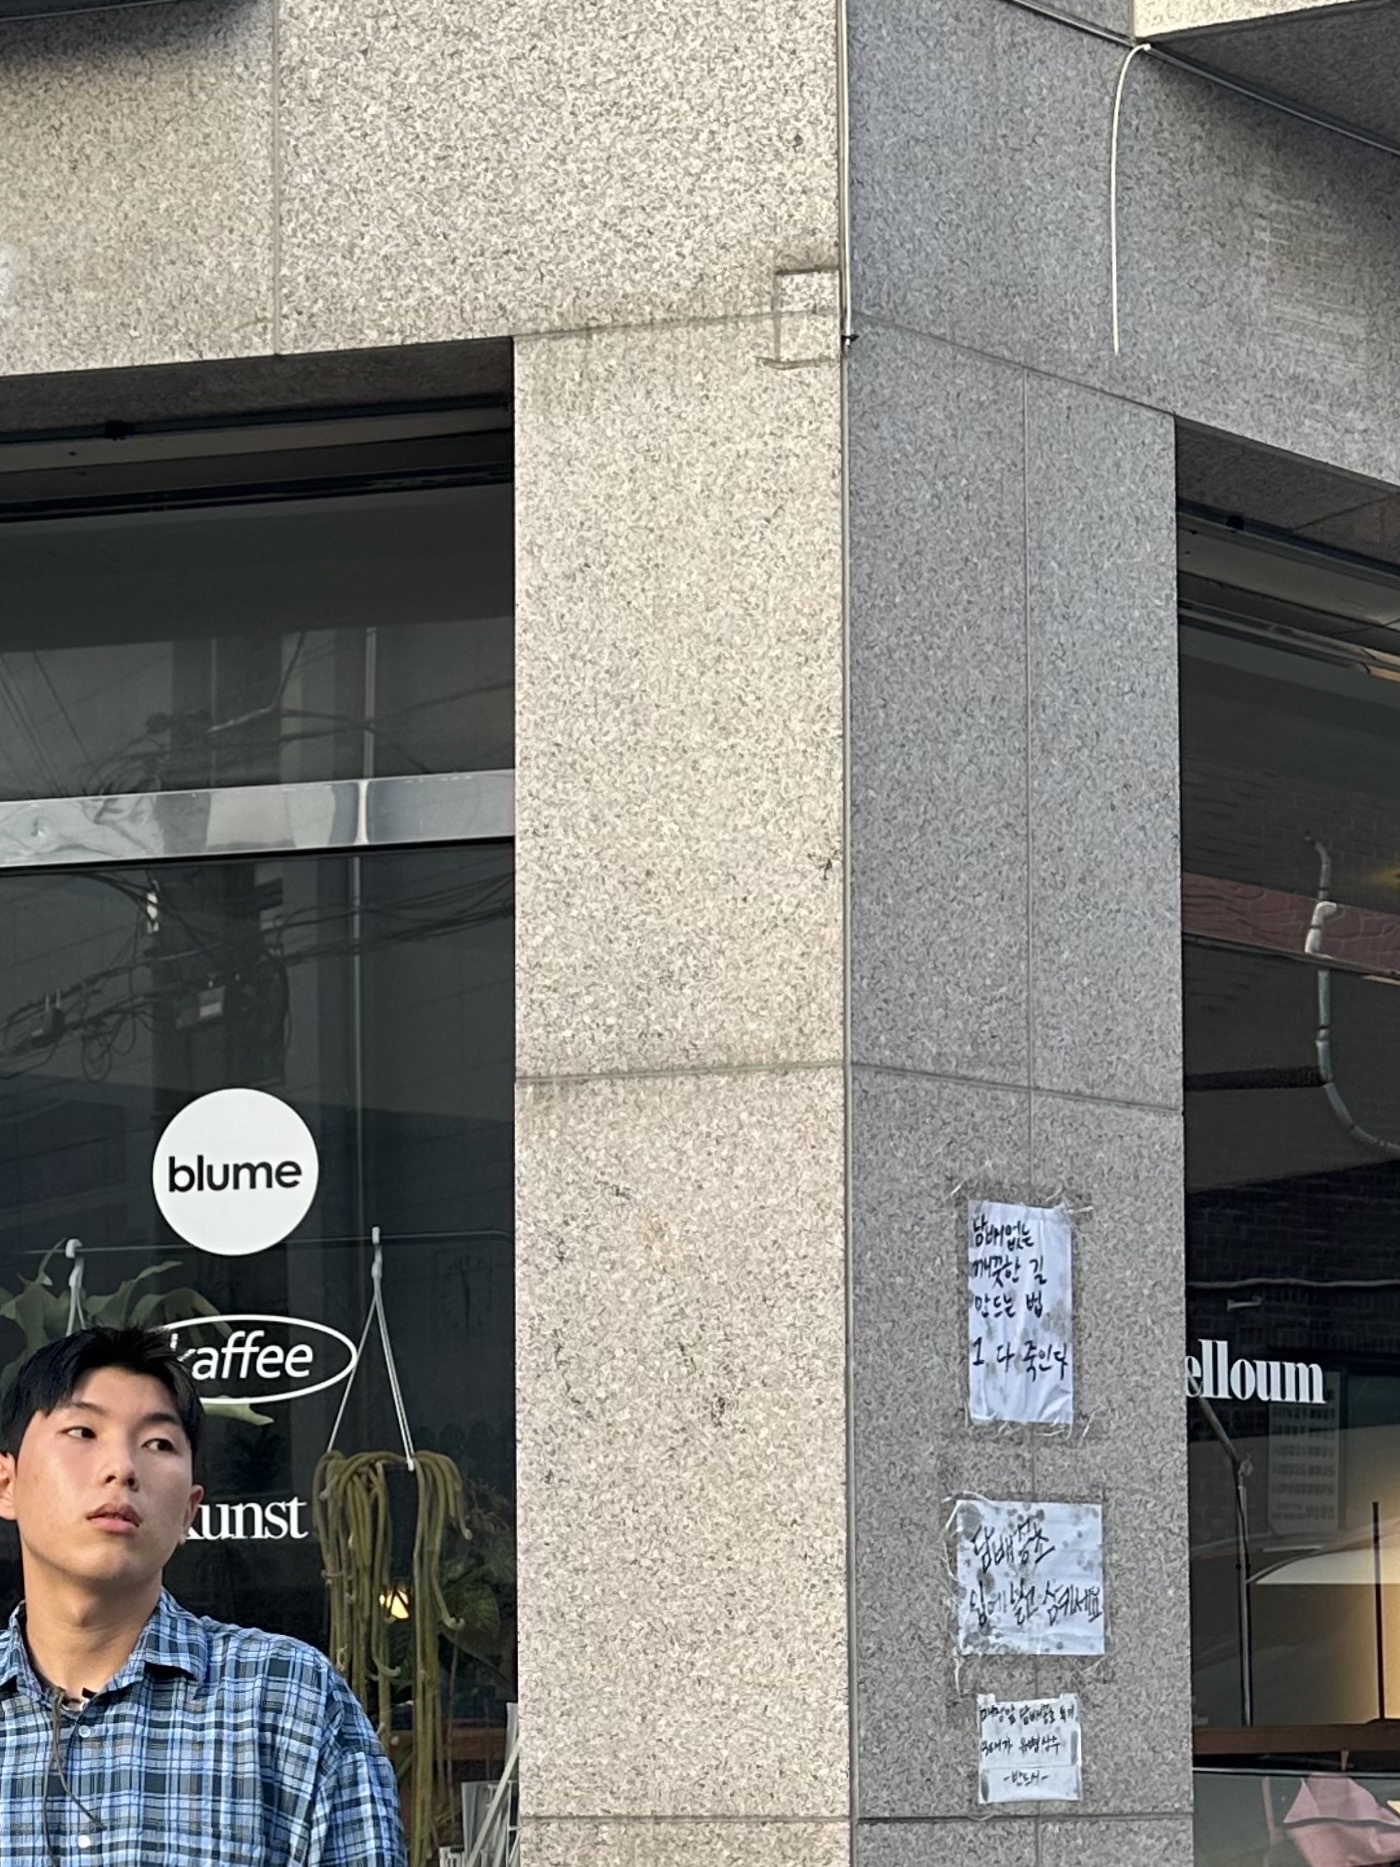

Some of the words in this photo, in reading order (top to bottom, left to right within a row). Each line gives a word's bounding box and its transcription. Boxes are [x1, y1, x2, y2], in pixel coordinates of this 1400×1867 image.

[168, 1155, 302, 1192] blume
[972, 1255, 1021, 1288] 깨끗한
[1029, 1255, 1048, 1285] 길
[974, 1293, 1016, 1318] 만드는
[1025, 1290, 1043, 1319] 법
[996, 1342, 1015, 1373] 다
[1022, 1340, 1069, 1381] 죽인다
[186, 1496, 309, 1540] unst
